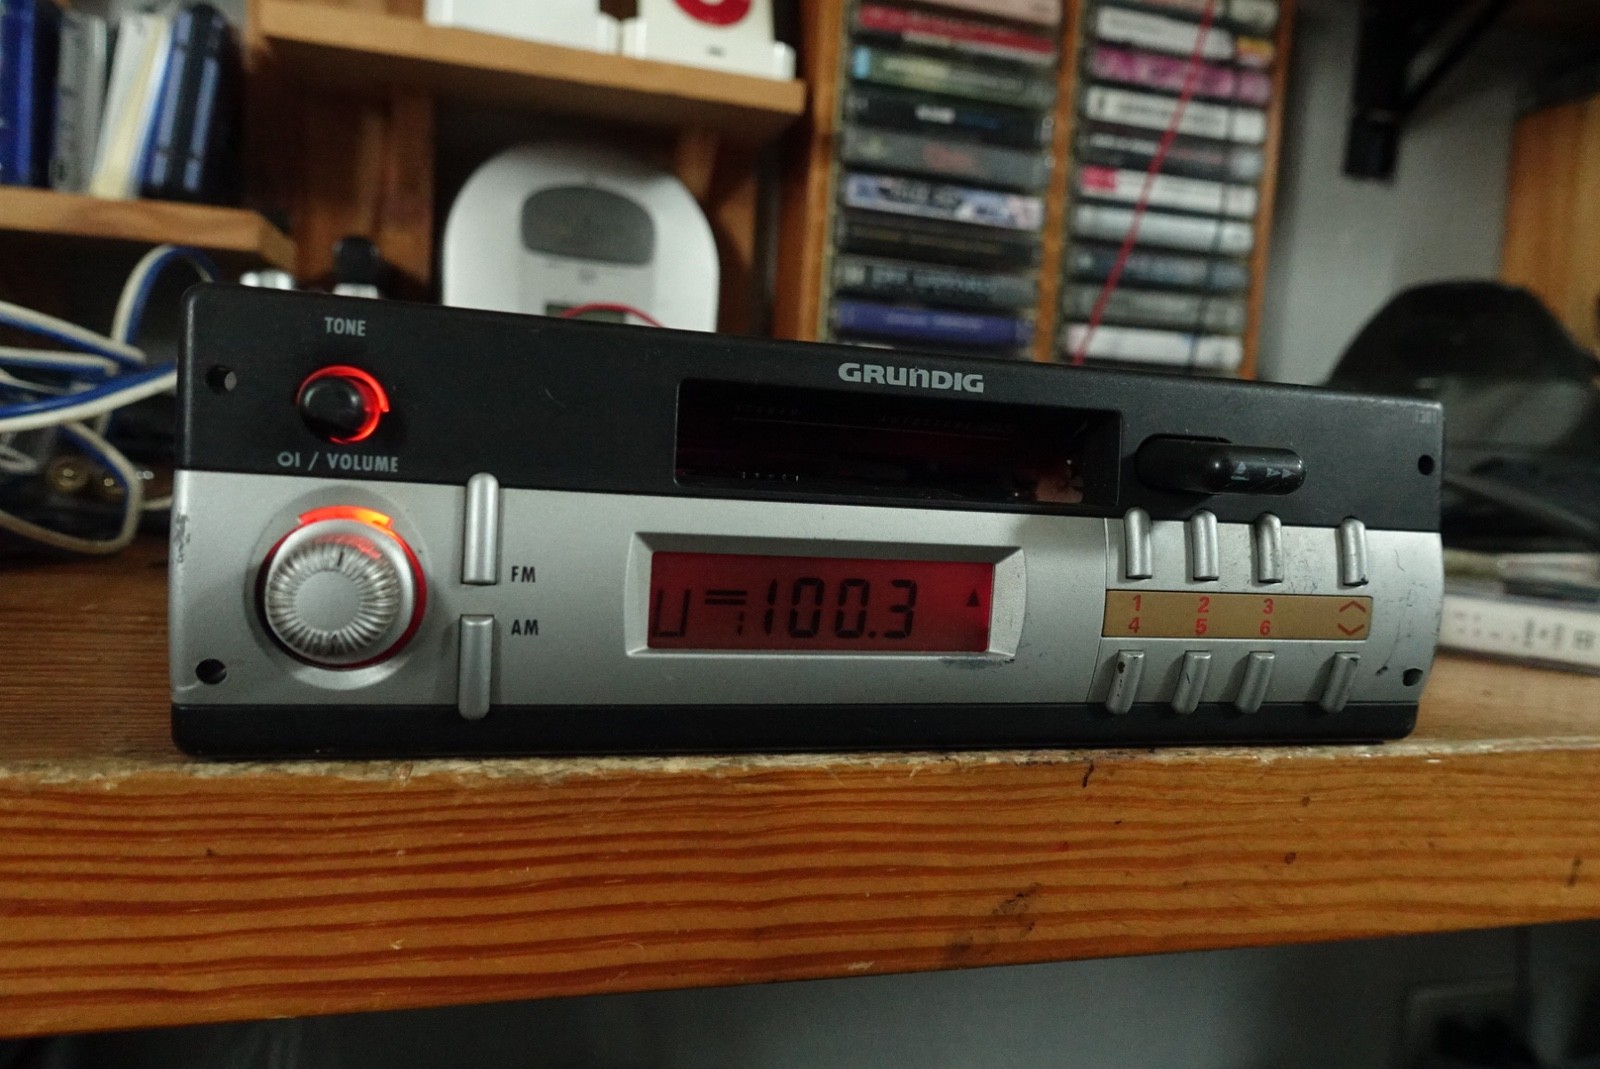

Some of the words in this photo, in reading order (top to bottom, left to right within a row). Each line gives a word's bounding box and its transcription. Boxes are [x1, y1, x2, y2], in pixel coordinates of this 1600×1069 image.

[324, 316, 366, 337] TONE
[838, 362, 984, 393] GRUNDIG
[327, 453, 399, 473] VOLUME
[511, 566, 536, 583] FM
[1132, 594, 1142, 612] 1
[1197, 596, 1210, 614] 2
[1263, 598, 1274, 615] 3
[511, 619, 539, 636] AM
[1128, 617, 1141, 634] 4
[1195, 618, 1208, 635] 5
[1259, 619, 1272, 636] 6
